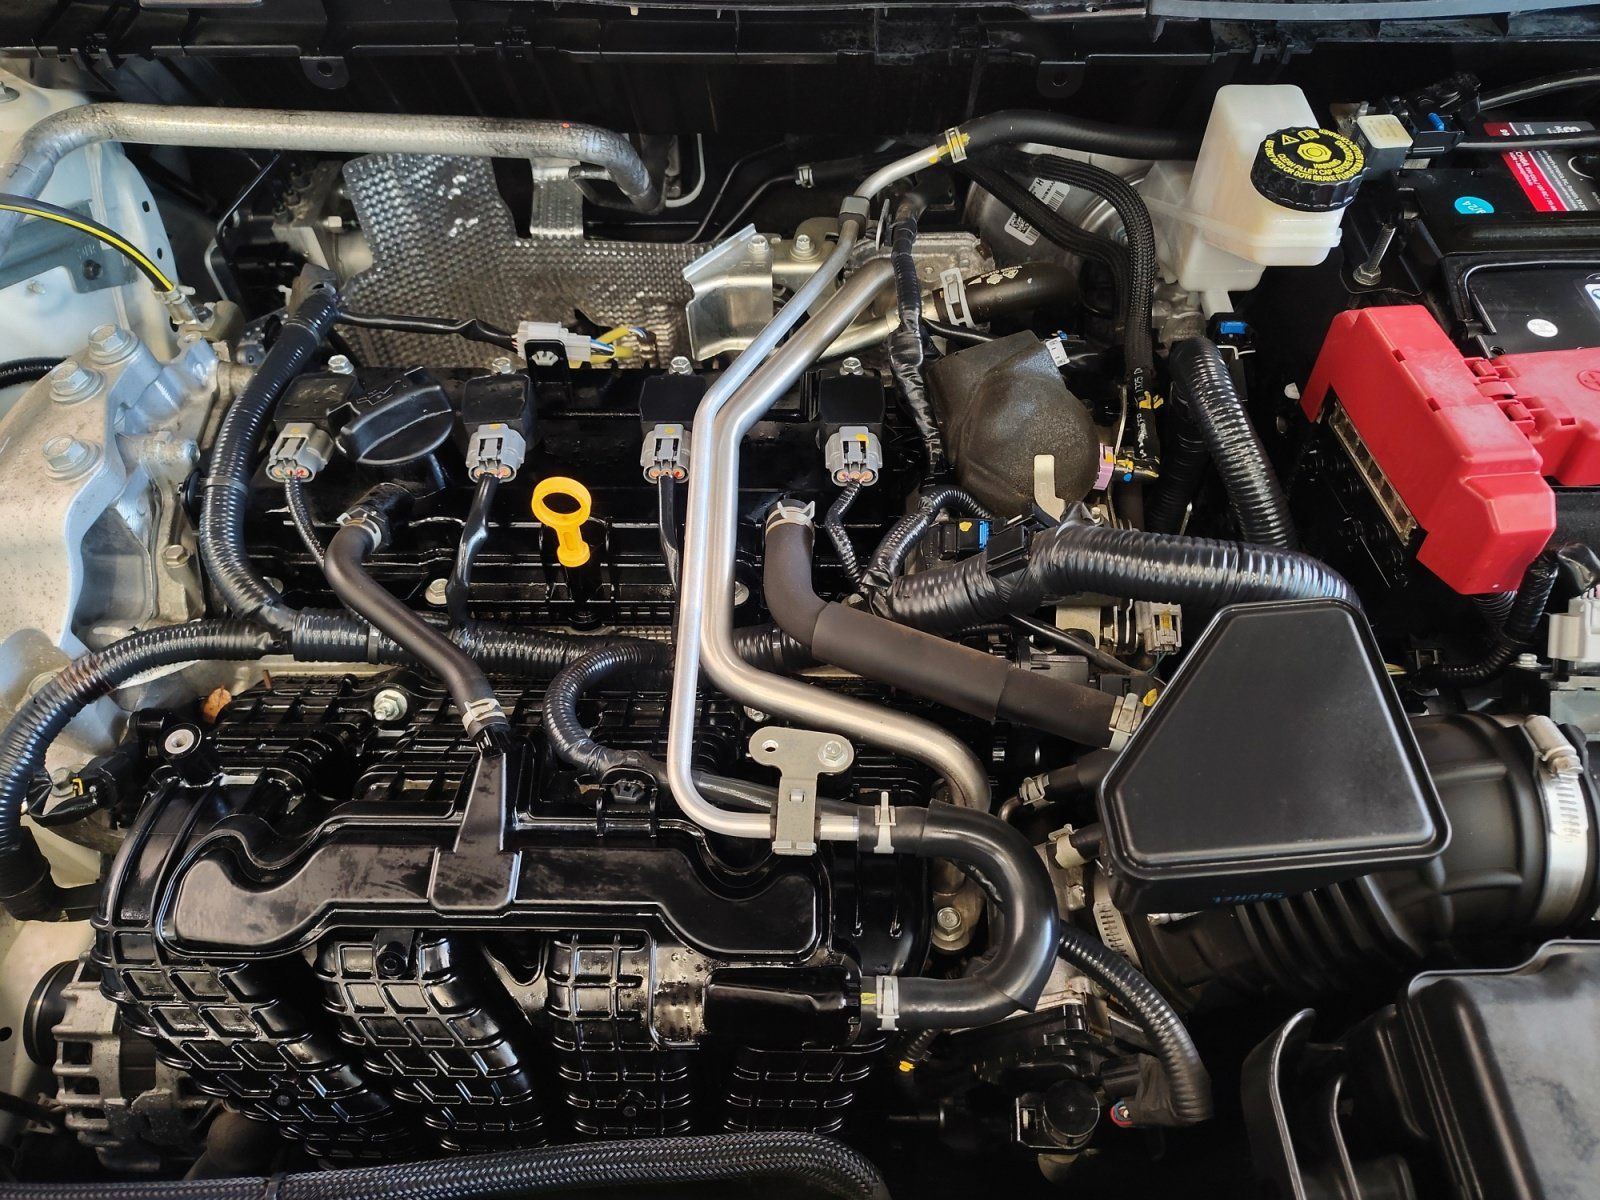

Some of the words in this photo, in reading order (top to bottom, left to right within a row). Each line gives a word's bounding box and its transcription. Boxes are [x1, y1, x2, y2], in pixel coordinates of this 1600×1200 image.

[1293, 164, 1318, 176] FILLER
[1313, 158, 1342, 170] WARNING
[1283, 166, 1295, 174] OR
[1293, 171, 1312, 180] DOT4
